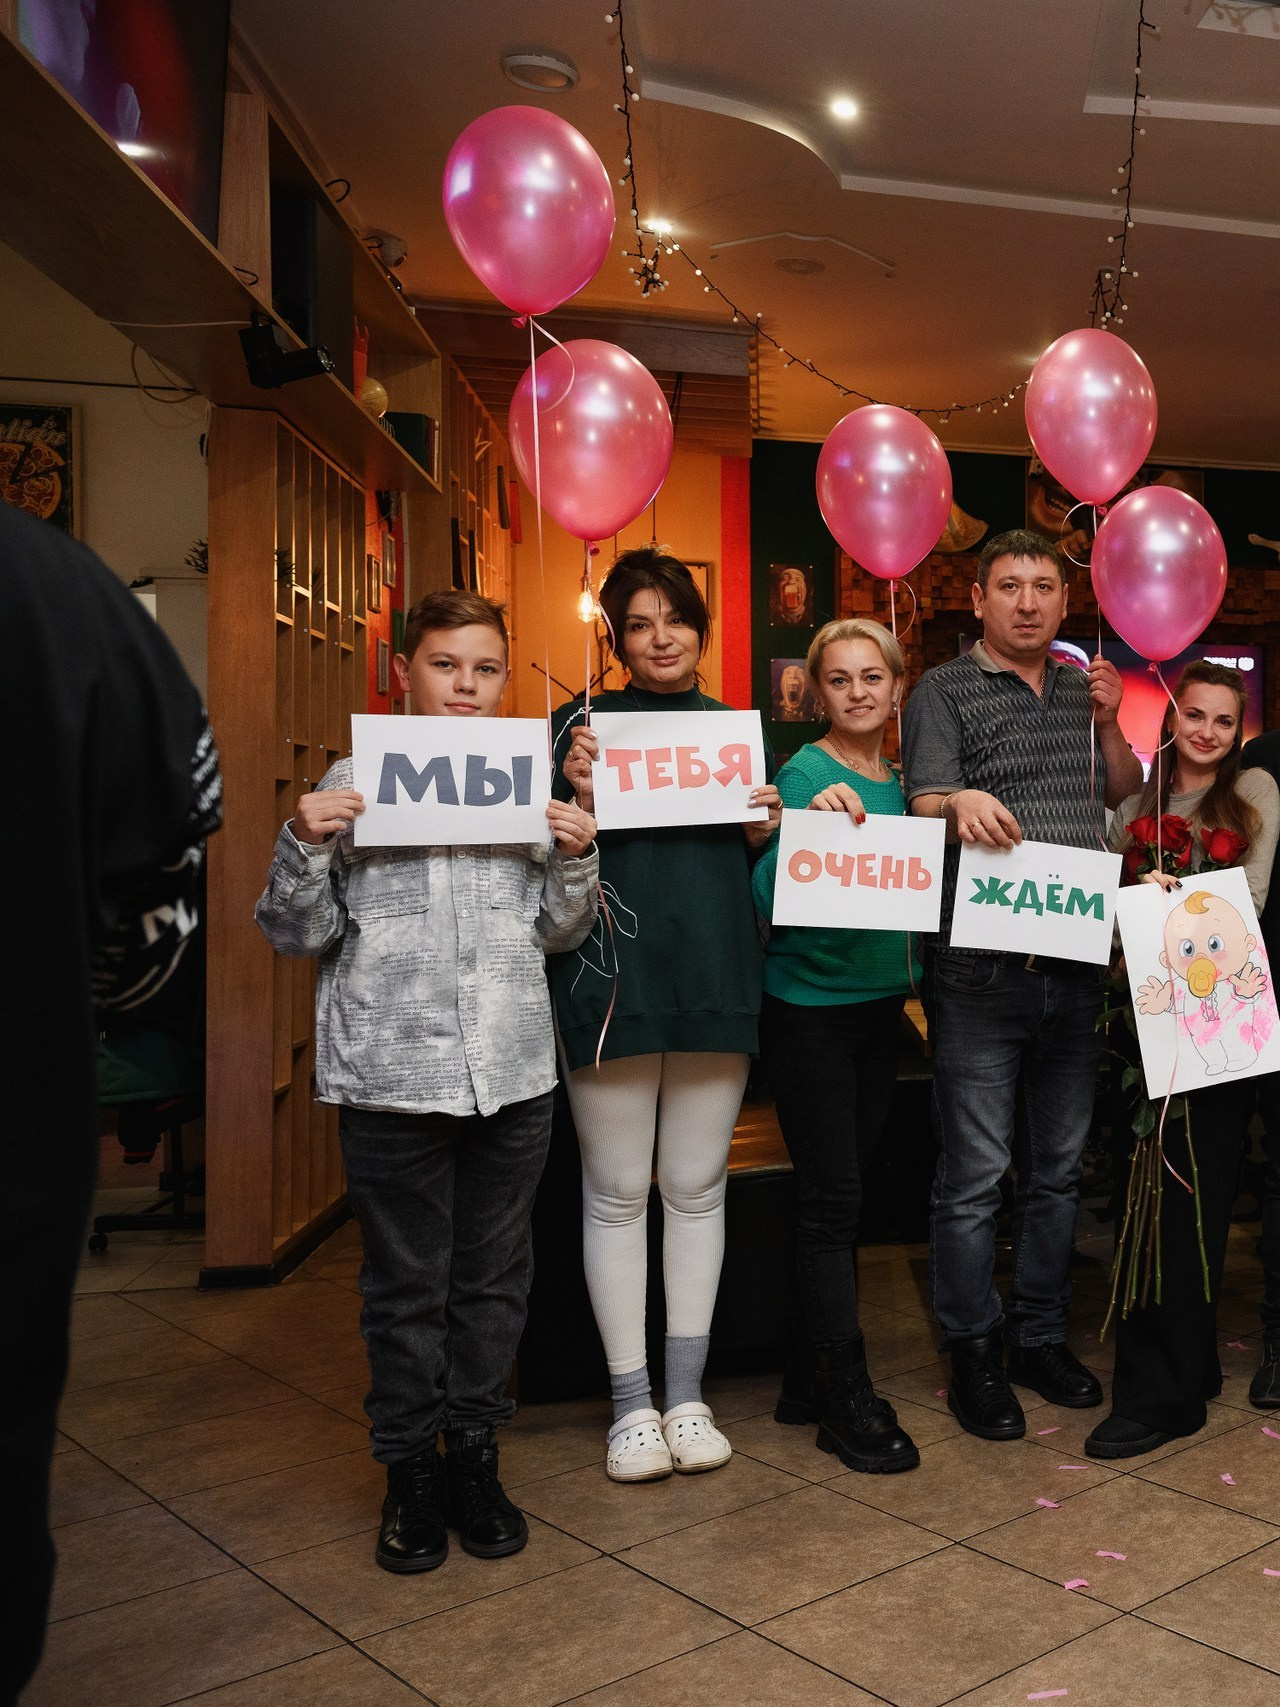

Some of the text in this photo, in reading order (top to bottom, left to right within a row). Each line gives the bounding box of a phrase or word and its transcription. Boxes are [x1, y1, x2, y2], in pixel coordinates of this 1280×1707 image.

[377, 753, 533, 807] МЫ
[605, 744, 752, 792] ТЕБЯ
[788, 849, 932, 891] ОЧЕНЬ
[968, 873, 1105, 921] ЖДЁМ
